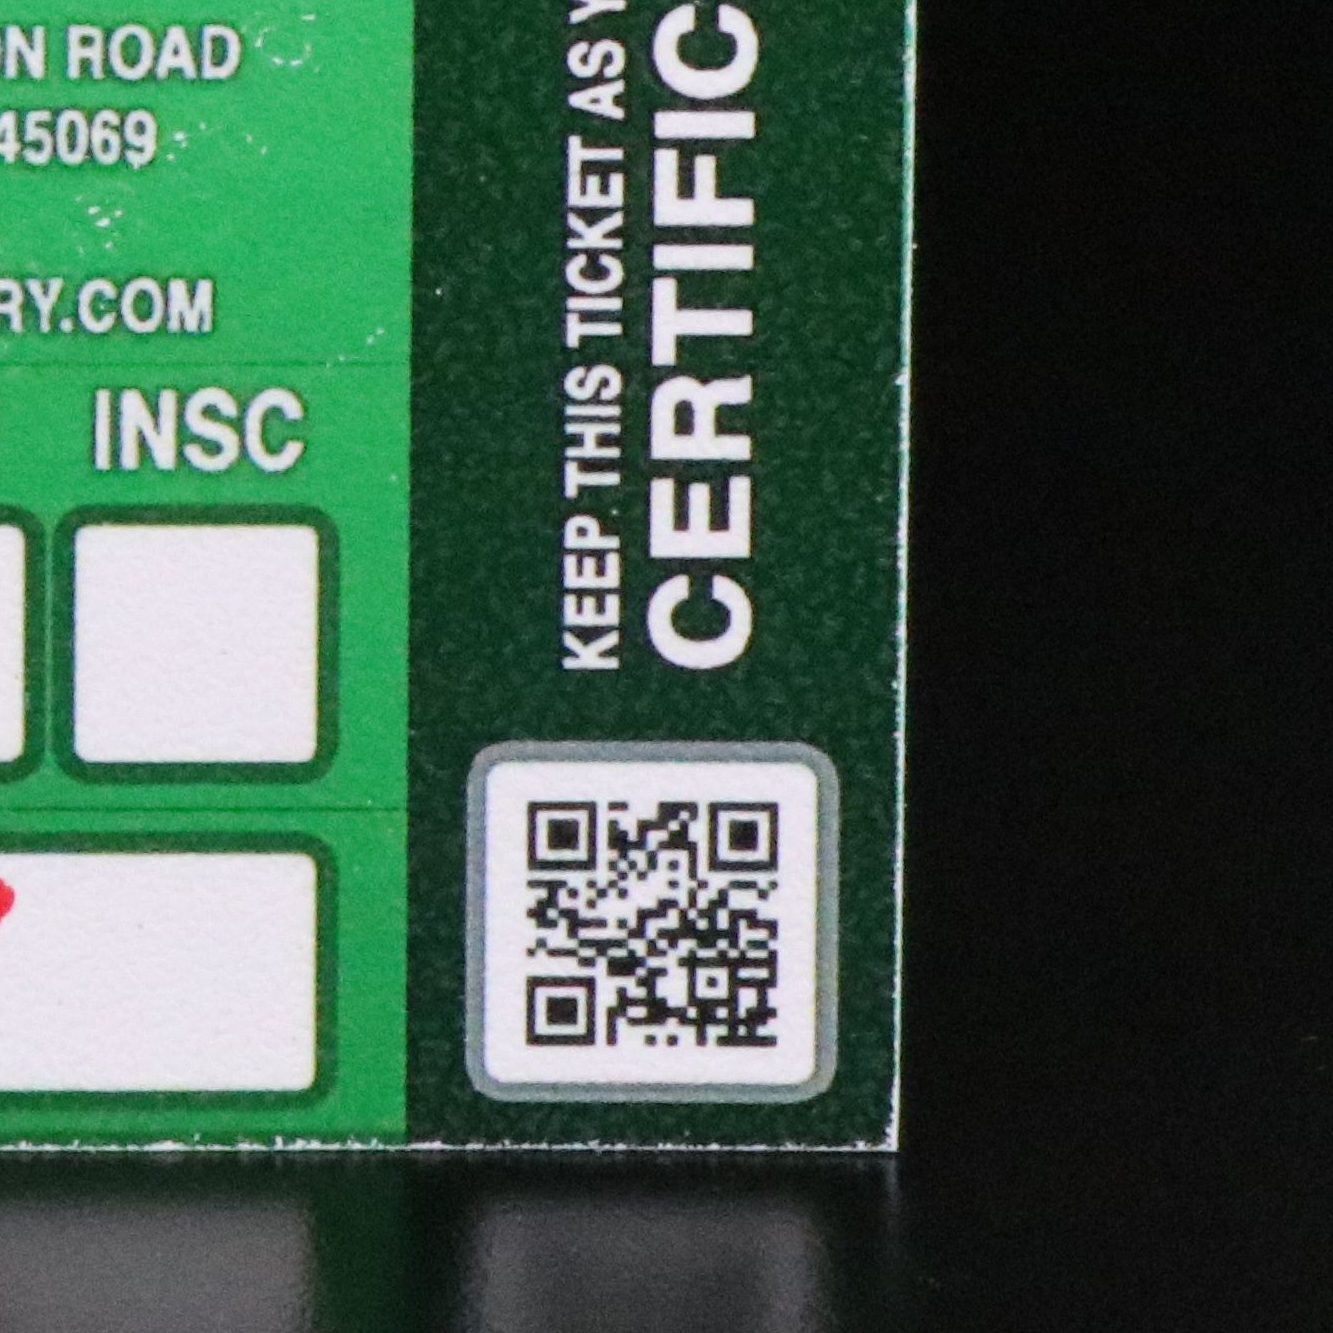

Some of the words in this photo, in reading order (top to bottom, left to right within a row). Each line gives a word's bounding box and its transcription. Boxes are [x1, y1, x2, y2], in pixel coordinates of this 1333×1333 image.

[67, 24, 243, 80] ROAD
[566, 39, 626, 120] AS
[564, 135, 625, 348] TICKET
[94, 385, 306, 474] INSC
[563, 363, 623, 498] THIS
[561, 515, 621, 671] KEEP
